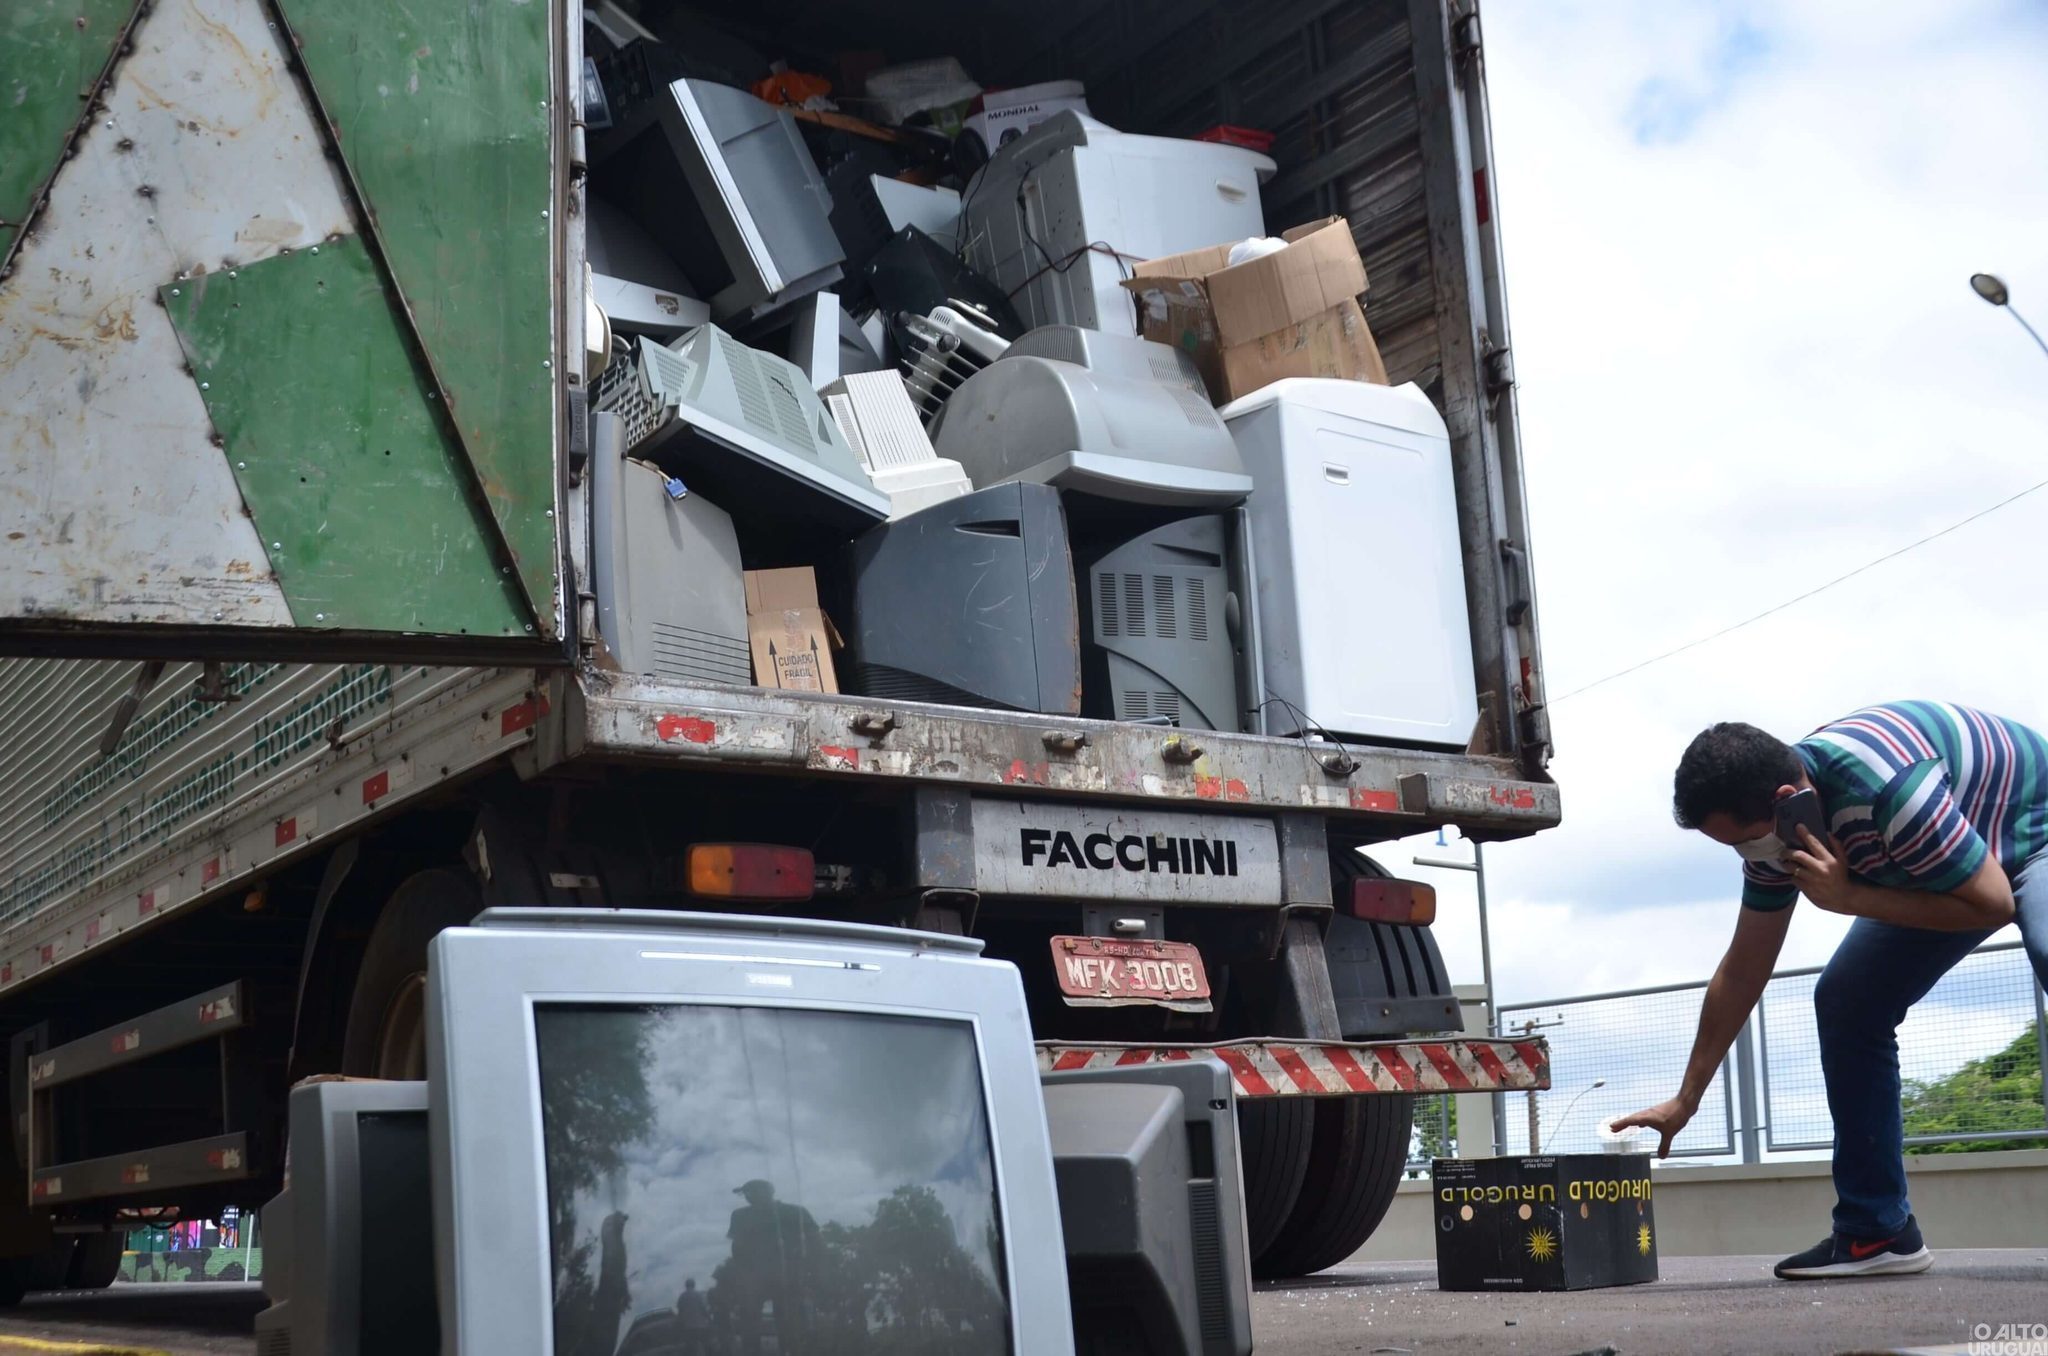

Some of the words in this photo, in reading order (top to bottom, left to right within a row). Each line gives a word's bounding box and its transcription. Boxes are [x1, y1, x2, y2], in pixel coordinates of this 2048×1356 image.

[988, 104, 1039, 121] MONDIAL
[778, 653, 814, 667] CUIDADO
[253, 663, 393, 778] Horizontina
[1020, 828, 1238, 876] FACCHINI
[1441, 1183, 1556, 1204] URUGOLD
[1569, 1178, 1651, 1202] URUGOLD
